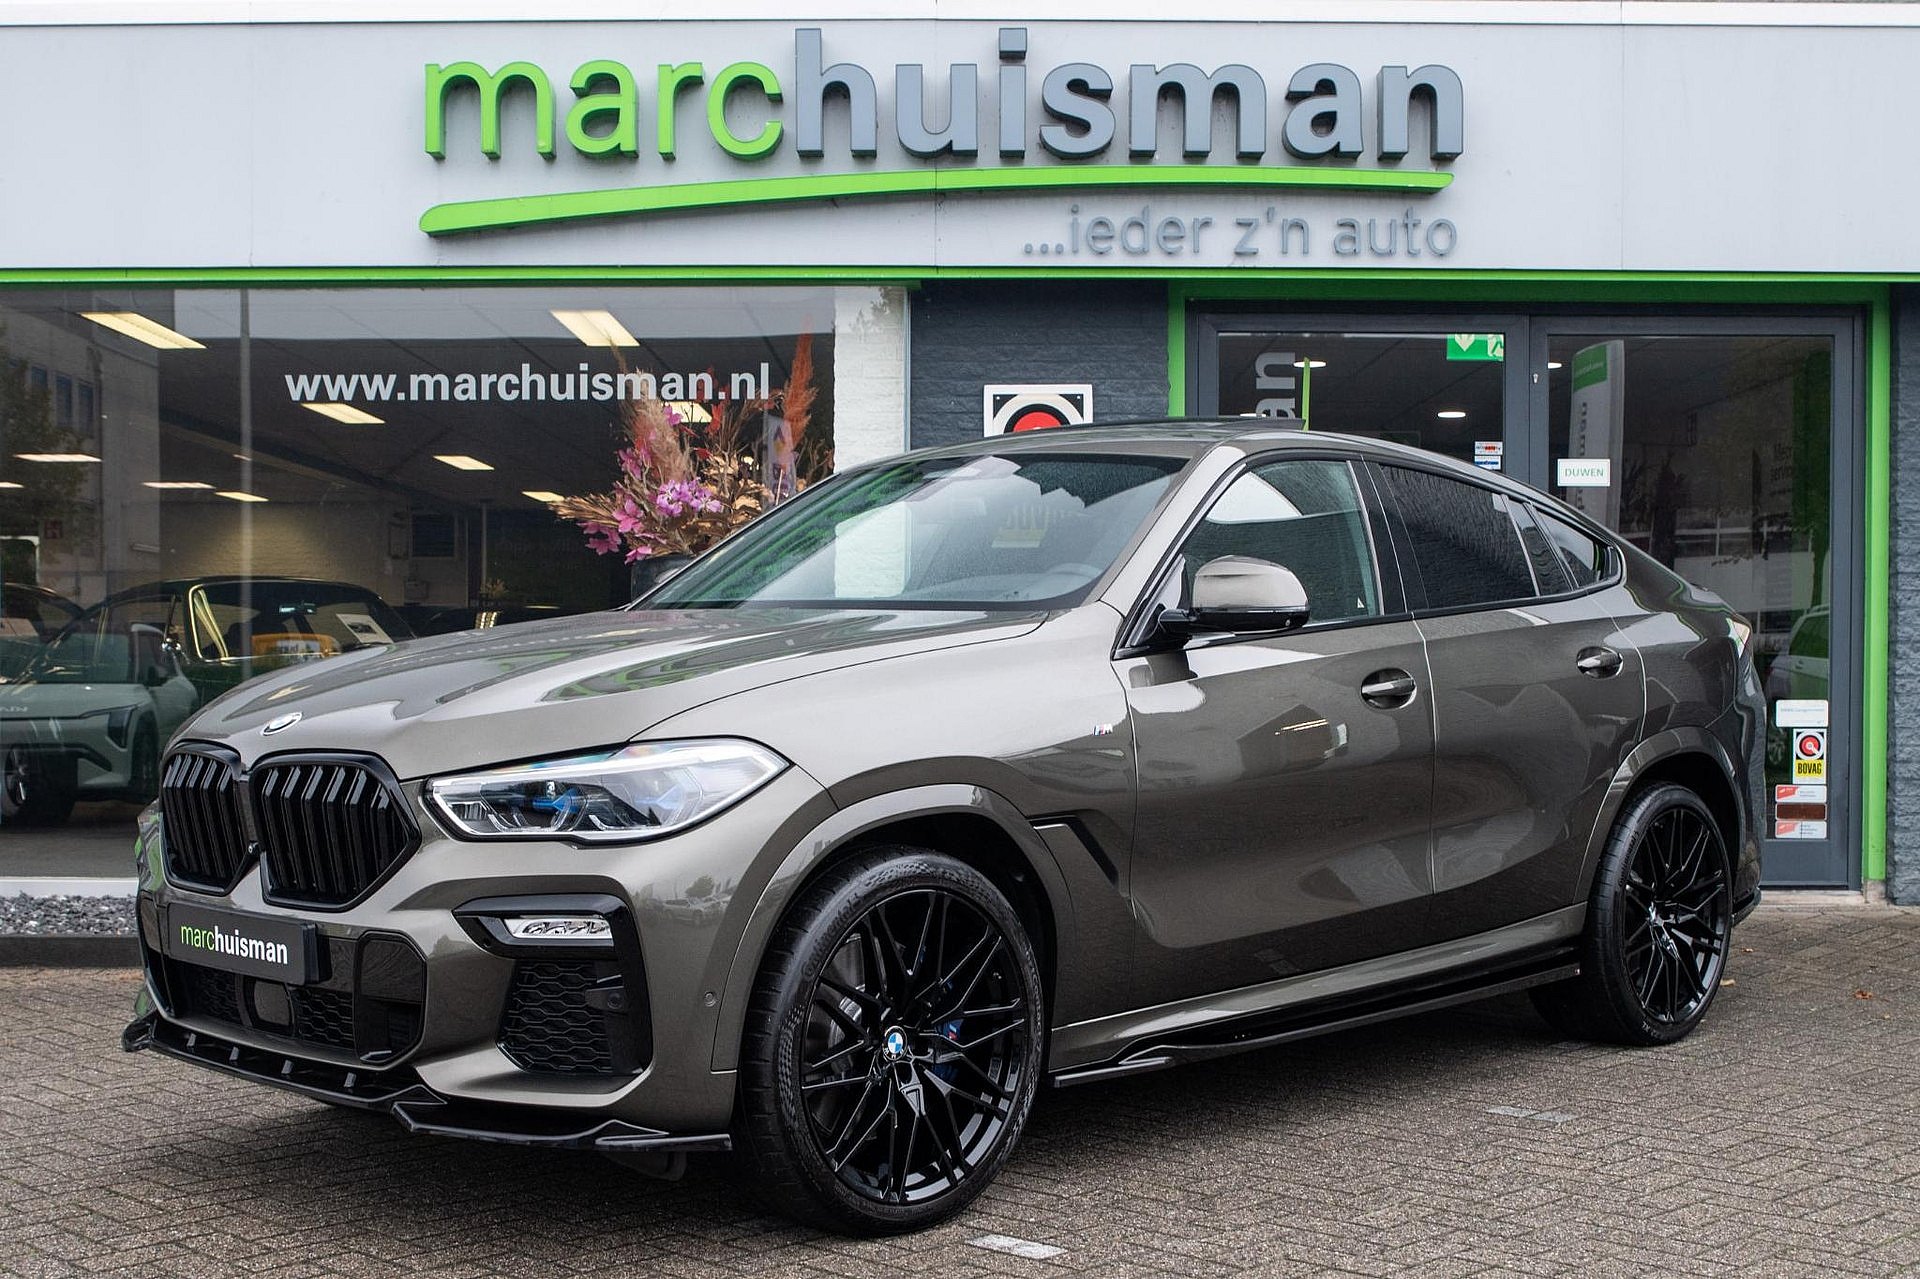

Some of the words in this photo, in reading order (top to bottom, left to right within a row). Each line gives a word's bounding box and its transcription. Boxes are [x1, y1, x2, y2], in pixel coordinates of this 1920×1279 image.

[425, 28, 1464, 161] marchuisman
[1024, 204, 1213, 255] ...ieder
[1234, 206, 1310, 255] z'n
[1333, 206, 1457, 256] auto
[285, 362, 770, 401] www.marchuisman.nl
[1565, 467, 1604, 477] DUWEN
[1797, 762, 1823, 775] BOVAG
[180, 925, 288, 965] marchuisman
